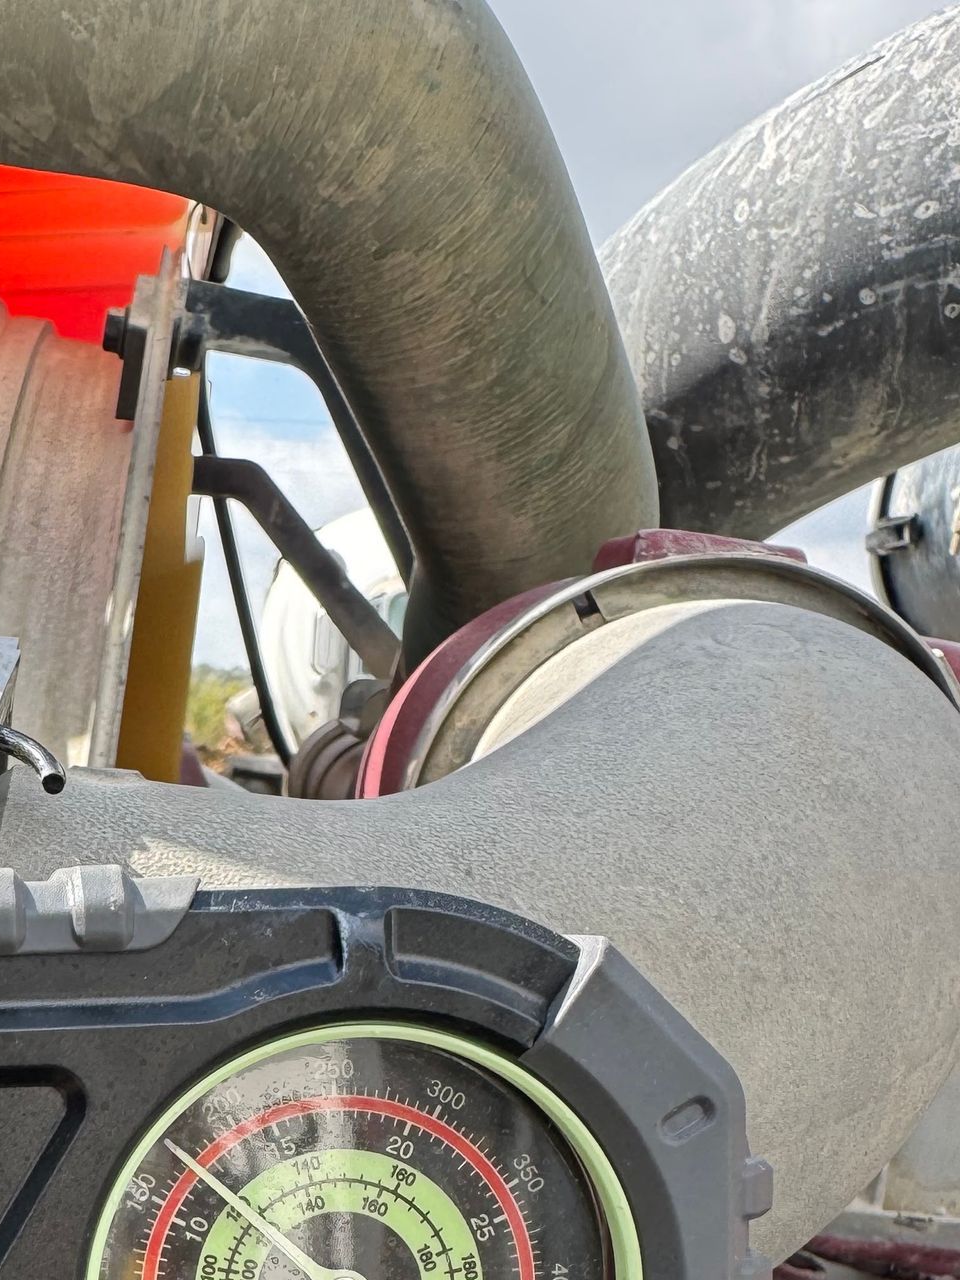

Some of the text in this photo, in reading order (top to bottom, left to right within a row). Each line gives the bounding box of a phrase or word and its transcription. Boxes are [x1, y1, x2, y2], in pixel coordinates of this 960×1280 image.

[427, 1079, 466, 1111] 300
[385, 1137, 414, 1159] 20
[390, 1164, 417, 1188] 160
[513, 1154, 544, 1194] 350
[361, 1196, 389, 1217] 160
[185, 1216, 209, 1242] 10
[470, 1213, 496, 1242] 25
[417, 1243, 437, 1273] 180
